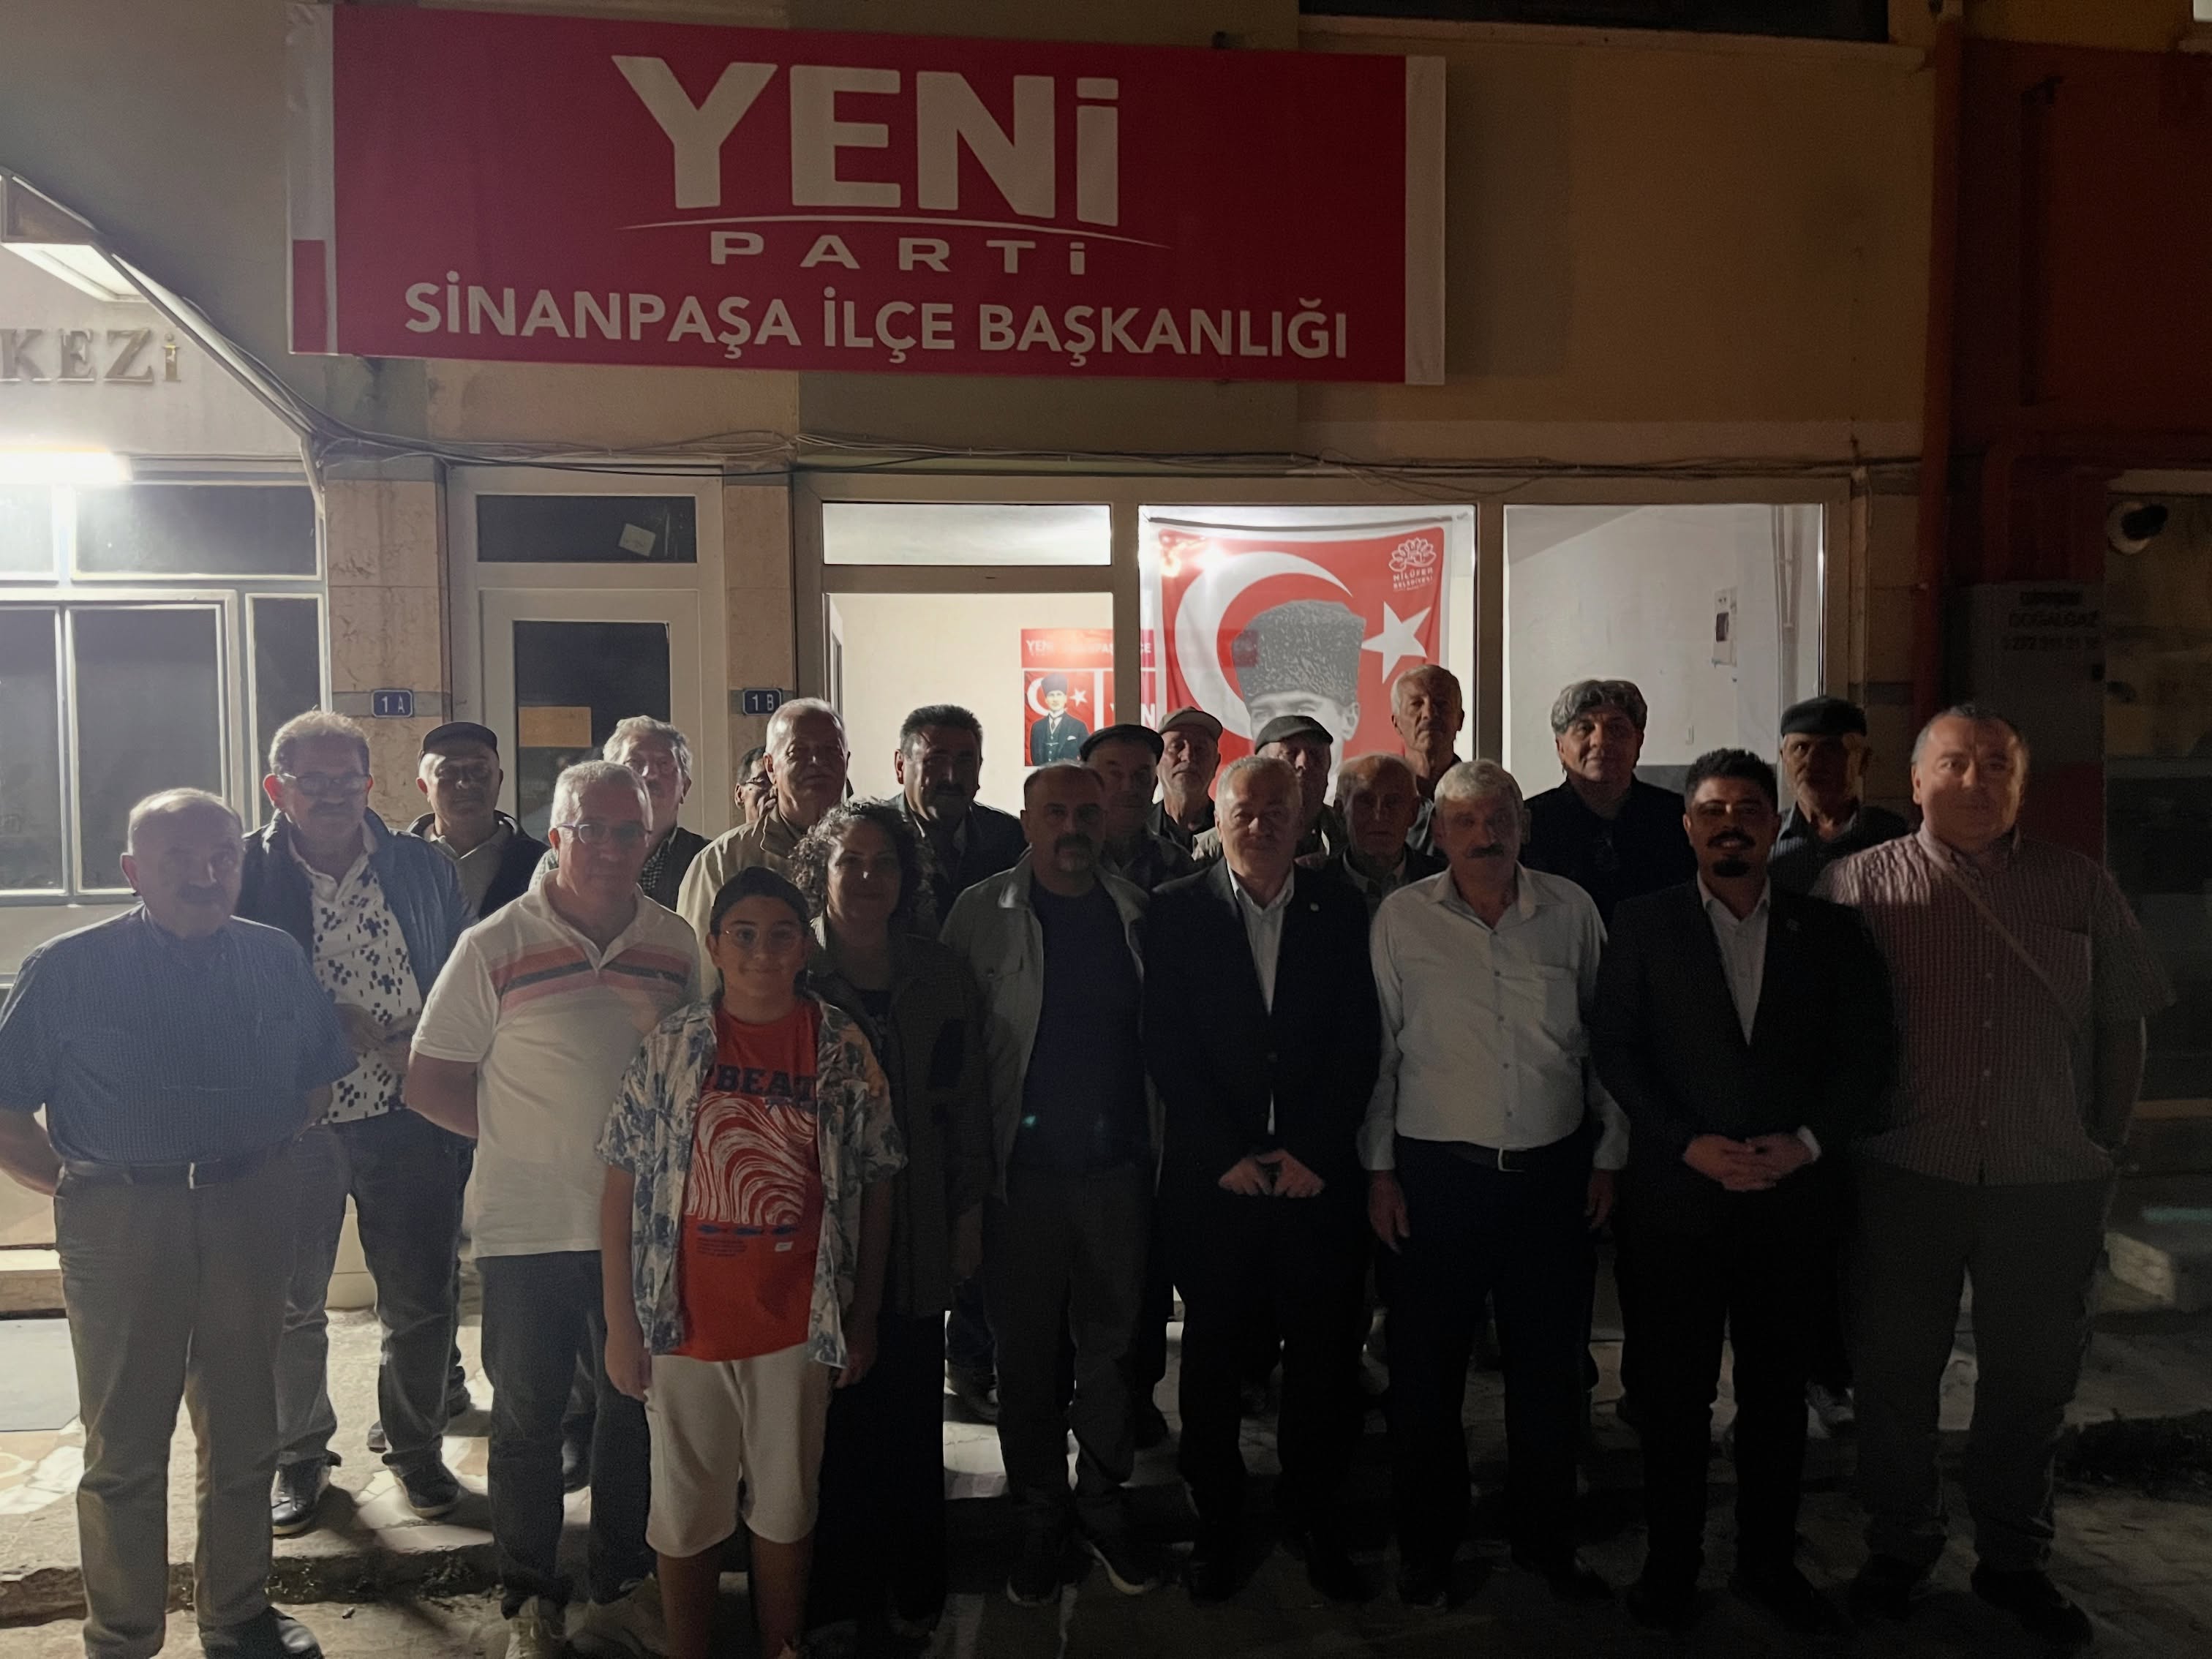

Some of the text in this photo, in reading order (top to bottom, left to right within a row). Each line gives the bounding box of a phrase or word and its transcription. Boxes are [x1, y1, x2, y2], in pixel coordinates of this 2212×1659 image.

[404, 270, 1348, 367] SİNANPAŞA İLÇE BAŞKANLIĞI
